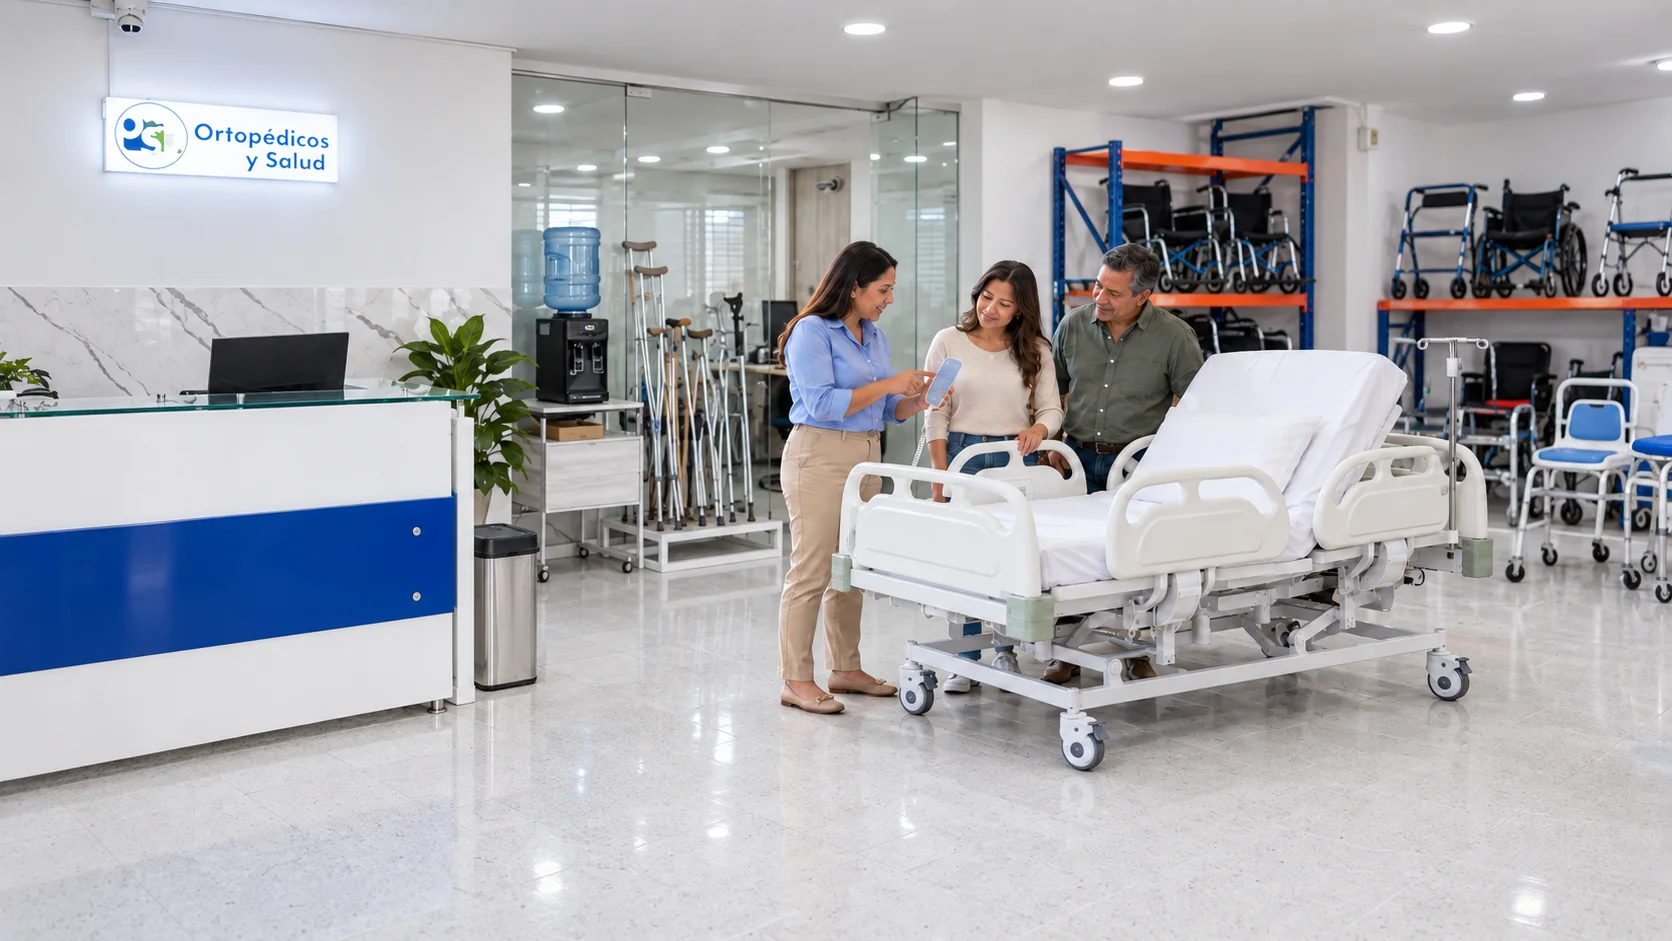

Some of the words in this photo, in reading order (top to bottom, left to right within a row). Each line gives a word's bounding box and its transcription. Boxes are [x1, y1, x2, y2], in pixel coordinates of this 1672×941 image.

[194, 123, 329, 149] Ortopédicos
[246, 155, 259, 172] y
[266, 151, 325, 171] Salud
